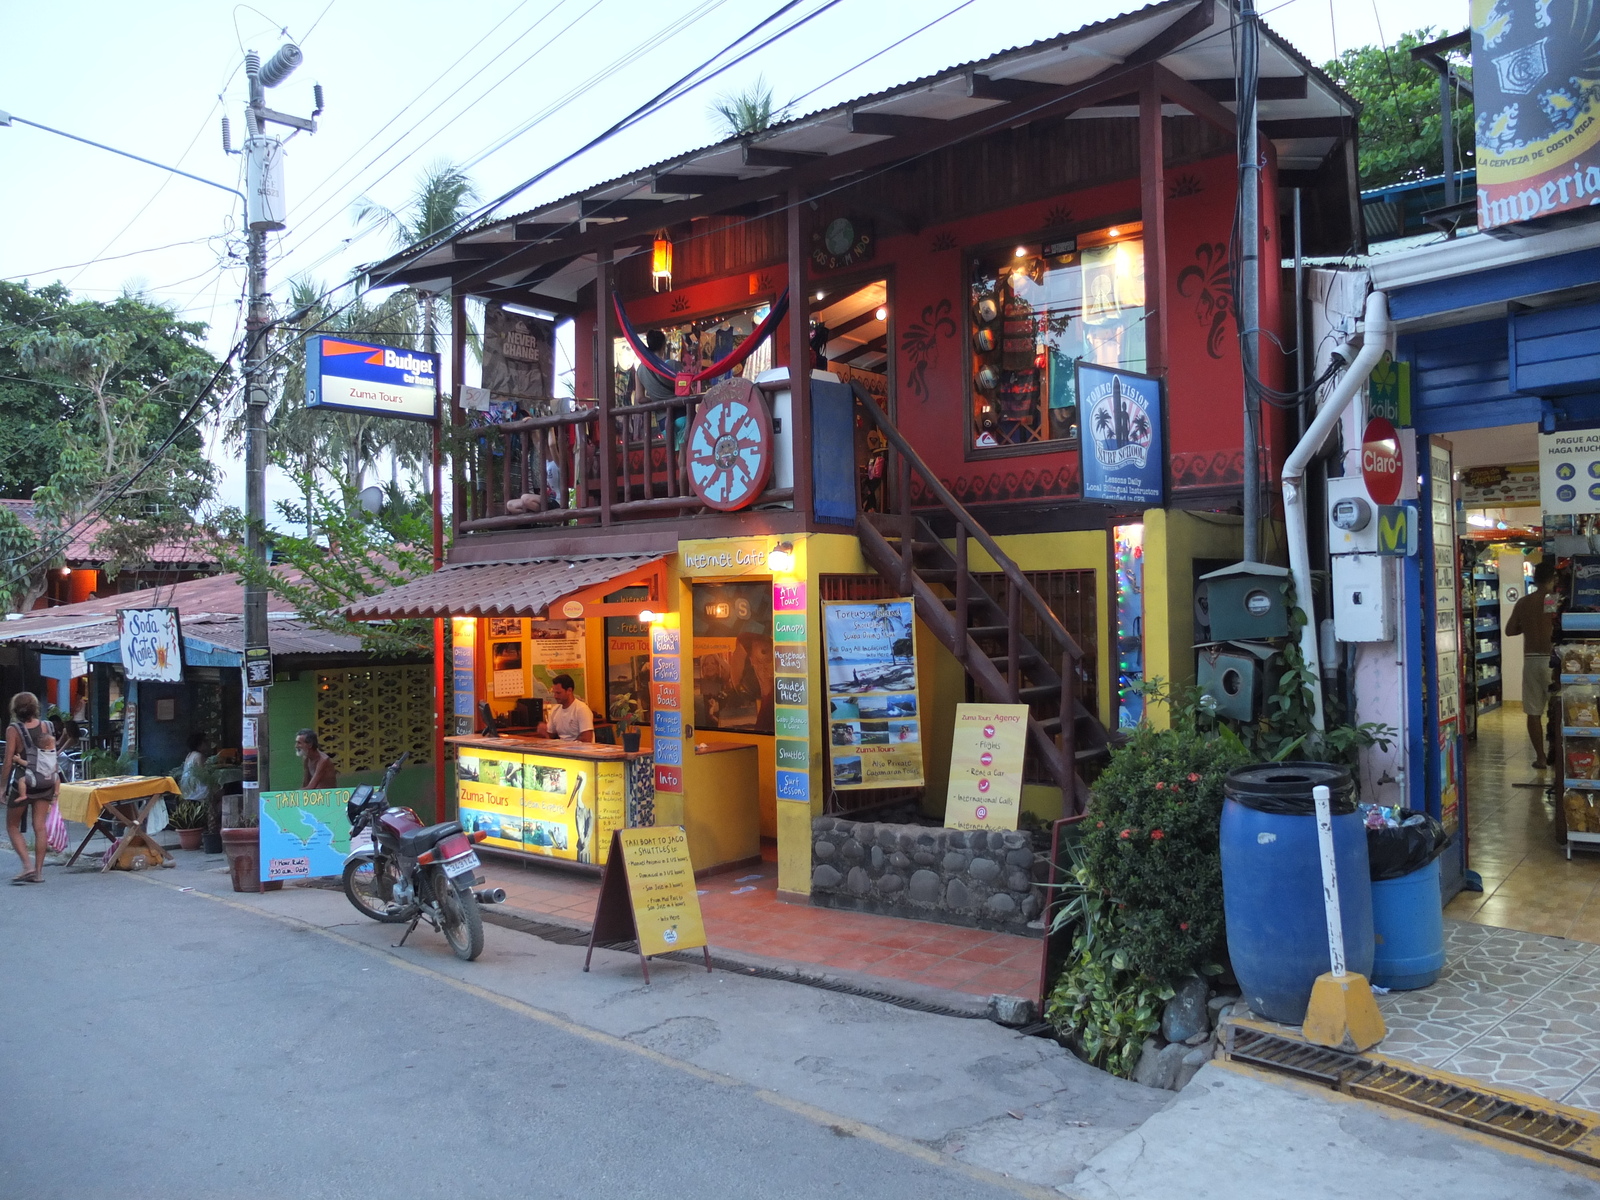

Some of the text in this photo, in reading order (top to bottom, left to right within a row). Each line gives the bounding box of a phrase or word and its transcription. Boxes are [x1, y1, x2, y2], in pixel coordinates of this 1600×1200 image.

[1478, 115, 1595, 168] LA CERVEZA DE COSTA RICA
[507, 331, 536, 348] NEVER
[503, 343, 540, 361] CHANGE
[384, 349, 434, 376] Budget
[350, 388, 403, 404] Zuma Tours
[1086, 382, 1149, 410] YOUNG VISION
[1368, 397, 1398, 420] kölbi
[1555, 435, 1600, 445] PAGUE AQ
[1097, 445, 1145, 464] SURF SCHOOL
[1363, 450, 1396, 474] Claro
[1086, 482, 1102, 491] Local
[1104, 475, 1142, 487] Lessons Daily
[685, 552, 734, 569] Internet
[780, 587, 798, 597] ATV
[779, 596, 799, 607] Tours
[835, 609, 874, 620] Tortuga
[130, 613, 160, 636] Soda
[621, 623, 638, 633] Free
[775, 621, 805, 635] Canopy
[654, 632, 679, 643] Tortuga
[843, 631, 861, 641] Scuba
[611, 640, 636, 651] Zuma
[656, 641, 675, 651] Island
[774, 651, 806, 661] Horseback
[657, 658, 675, 670] Sport
[780, 658, 801, 669] Riding
[654, 668, 679, 680] Fishing
[658, 684, 675, 695] Taxi
[776, 679, 806, 692] Guided
[657, 694, 677, 707] Boats
[780, 690, 802, 703] Hikes
[656, 713, 679, 724] Private
[993, 714, 1021, 723] Agency
[657, 739, 678, 751] Scuba
[979, 741, 1001, 750] Flights
[657, 750, 679, 763] Diving
[779, 747, 806, 760] Shuttles
[871, 759, 912, 768] Also Private
[902, 768, 920, 776] Tours
[993, 769, 1005, 777] Car
[659, 771, 678, 786] Info
[784, 774, 800, 787] Surf
[779, 784, 806, 797] Lessons
[275, 790, 350, 810] TAXI BOAT TO
[461, 788, 509, 807] Zuma Tours
[957, 795, 1014, 806] International Calls
[625, 839, 639, 847] TAXI
[640, 837, 656, 845] BOAT
[667, 835, 684, 844] JACO
[639, 845, 671, 856] SHUTTLES
